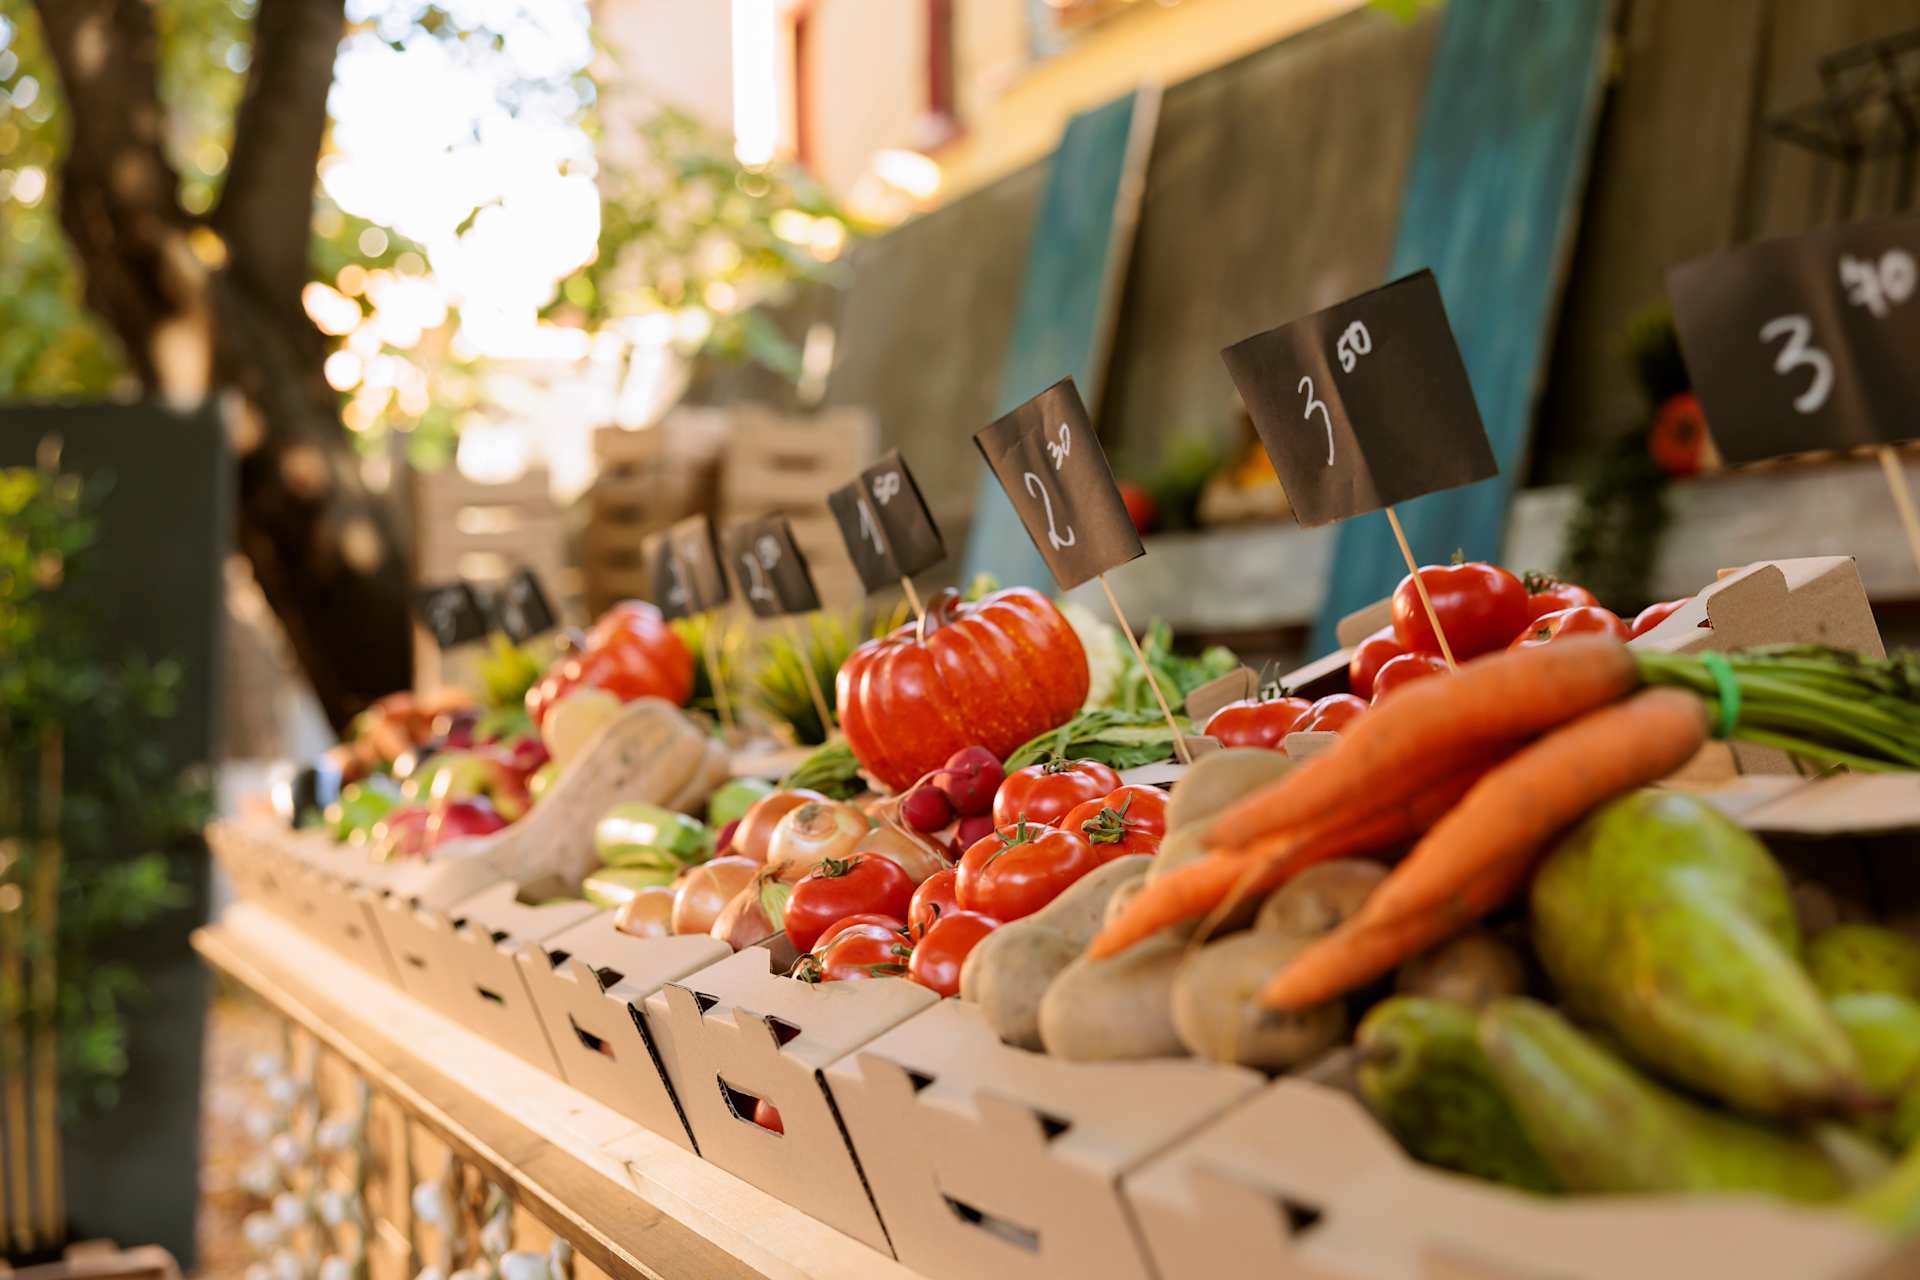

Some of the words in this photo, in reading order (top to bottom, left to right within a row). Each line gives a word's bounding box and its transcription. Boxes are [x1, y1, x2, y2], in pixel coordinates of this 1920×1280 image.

[1298, 375, 1335, 466] 3
[1337, 320, 1372, 373] 50
[1761, 315, 1834, 413] 3
[1047, 422, 1070, 470] 30
[1024, 471, 1076, 551] 2
